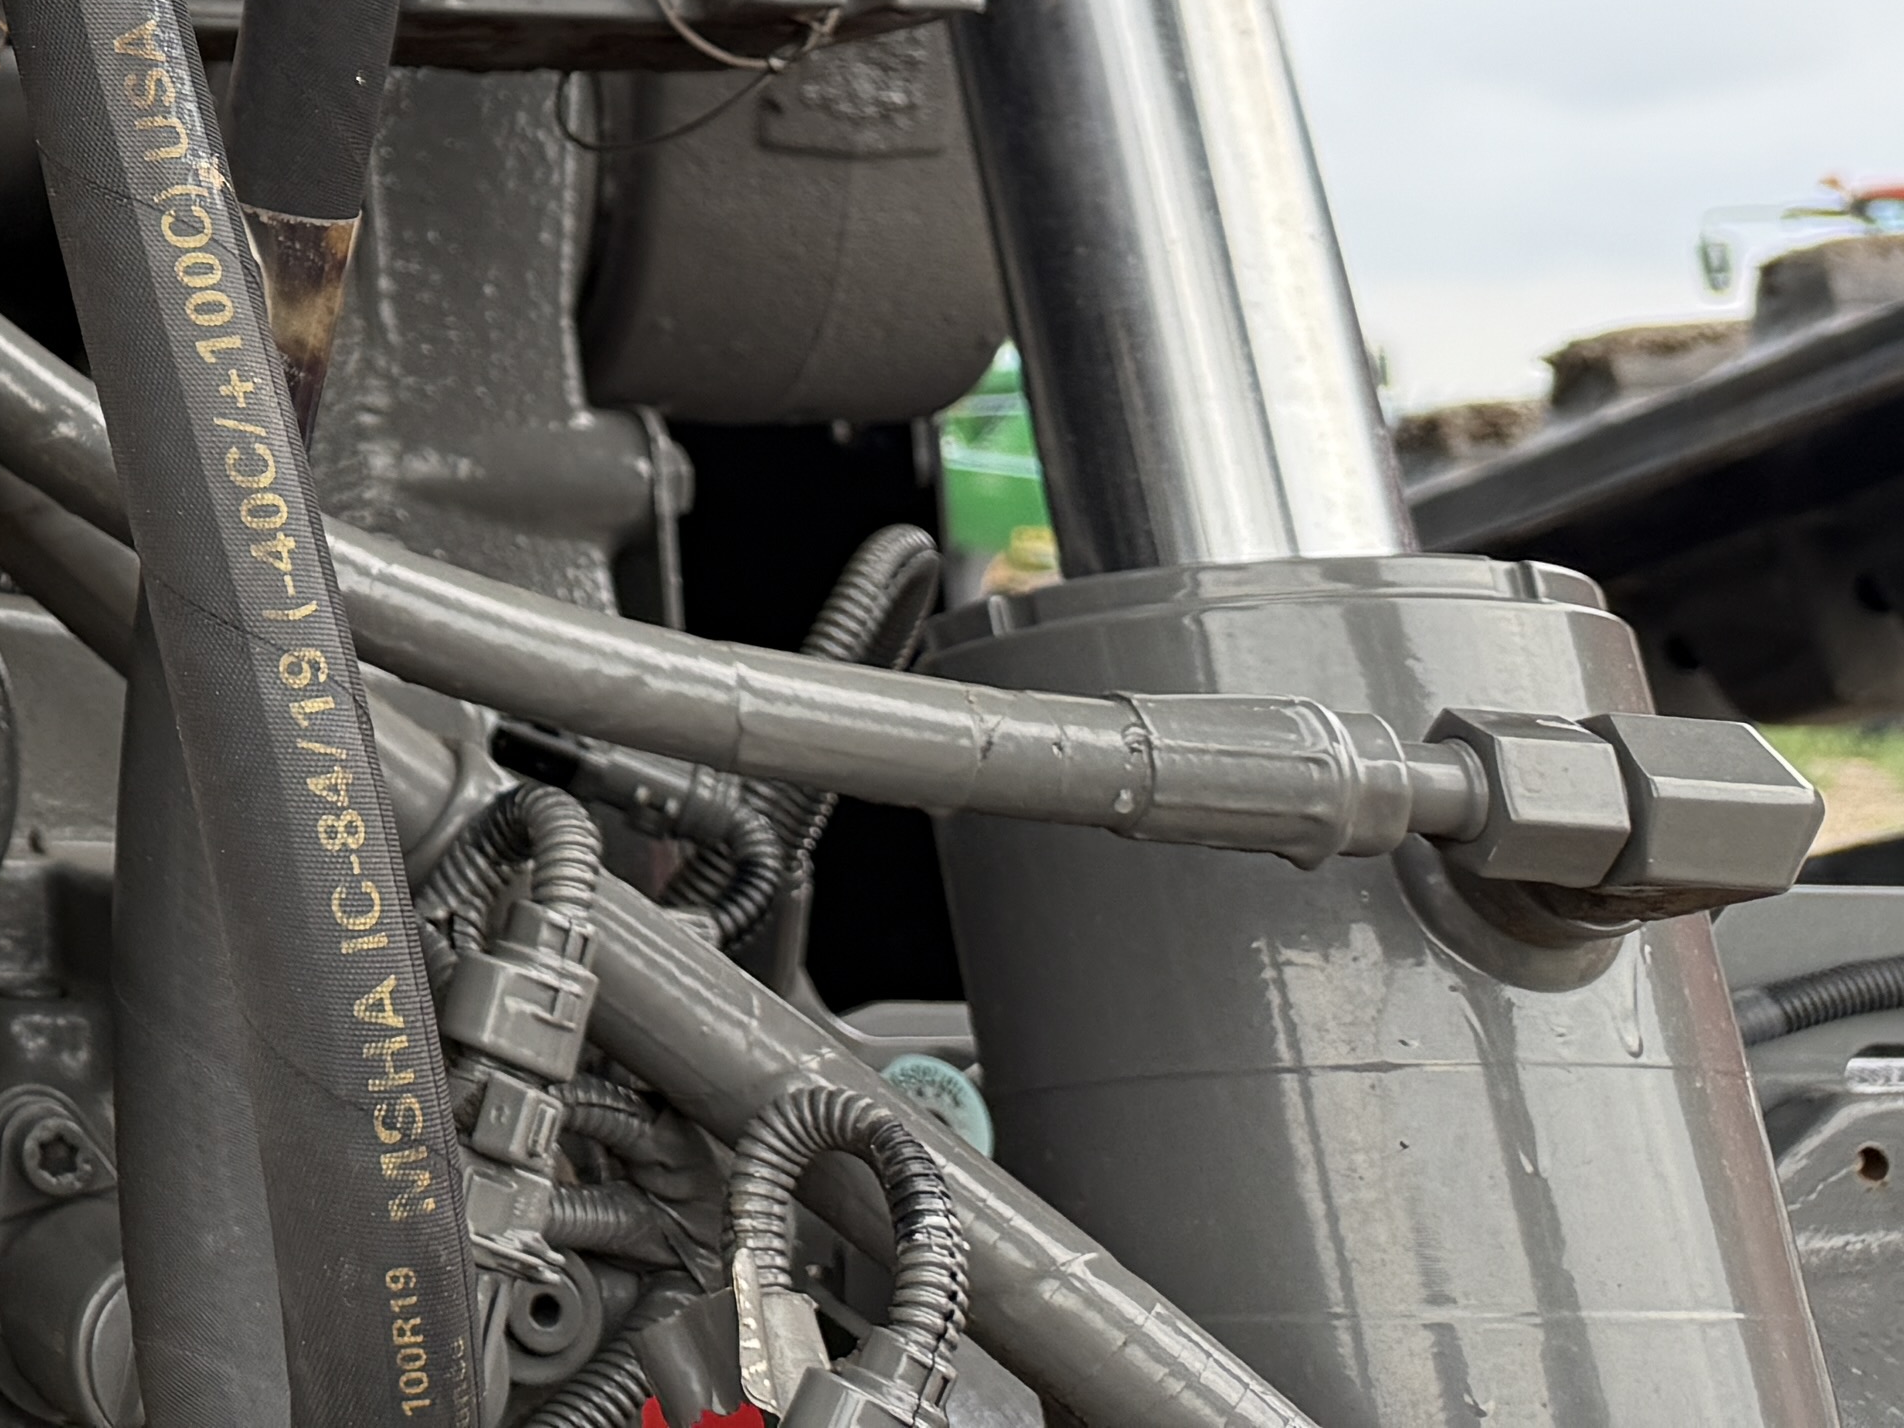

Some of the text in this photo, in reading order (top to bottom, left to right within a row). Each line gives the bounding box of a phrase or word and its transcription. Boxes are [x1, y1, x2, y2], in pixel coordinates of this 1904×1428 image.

[114, 19, 190, 163] USA
[278, 647, 389, 954] IC-84/19
[353, 974, 435, 1221] MSHA
[385, 1266, 430, 1417] 100R19
